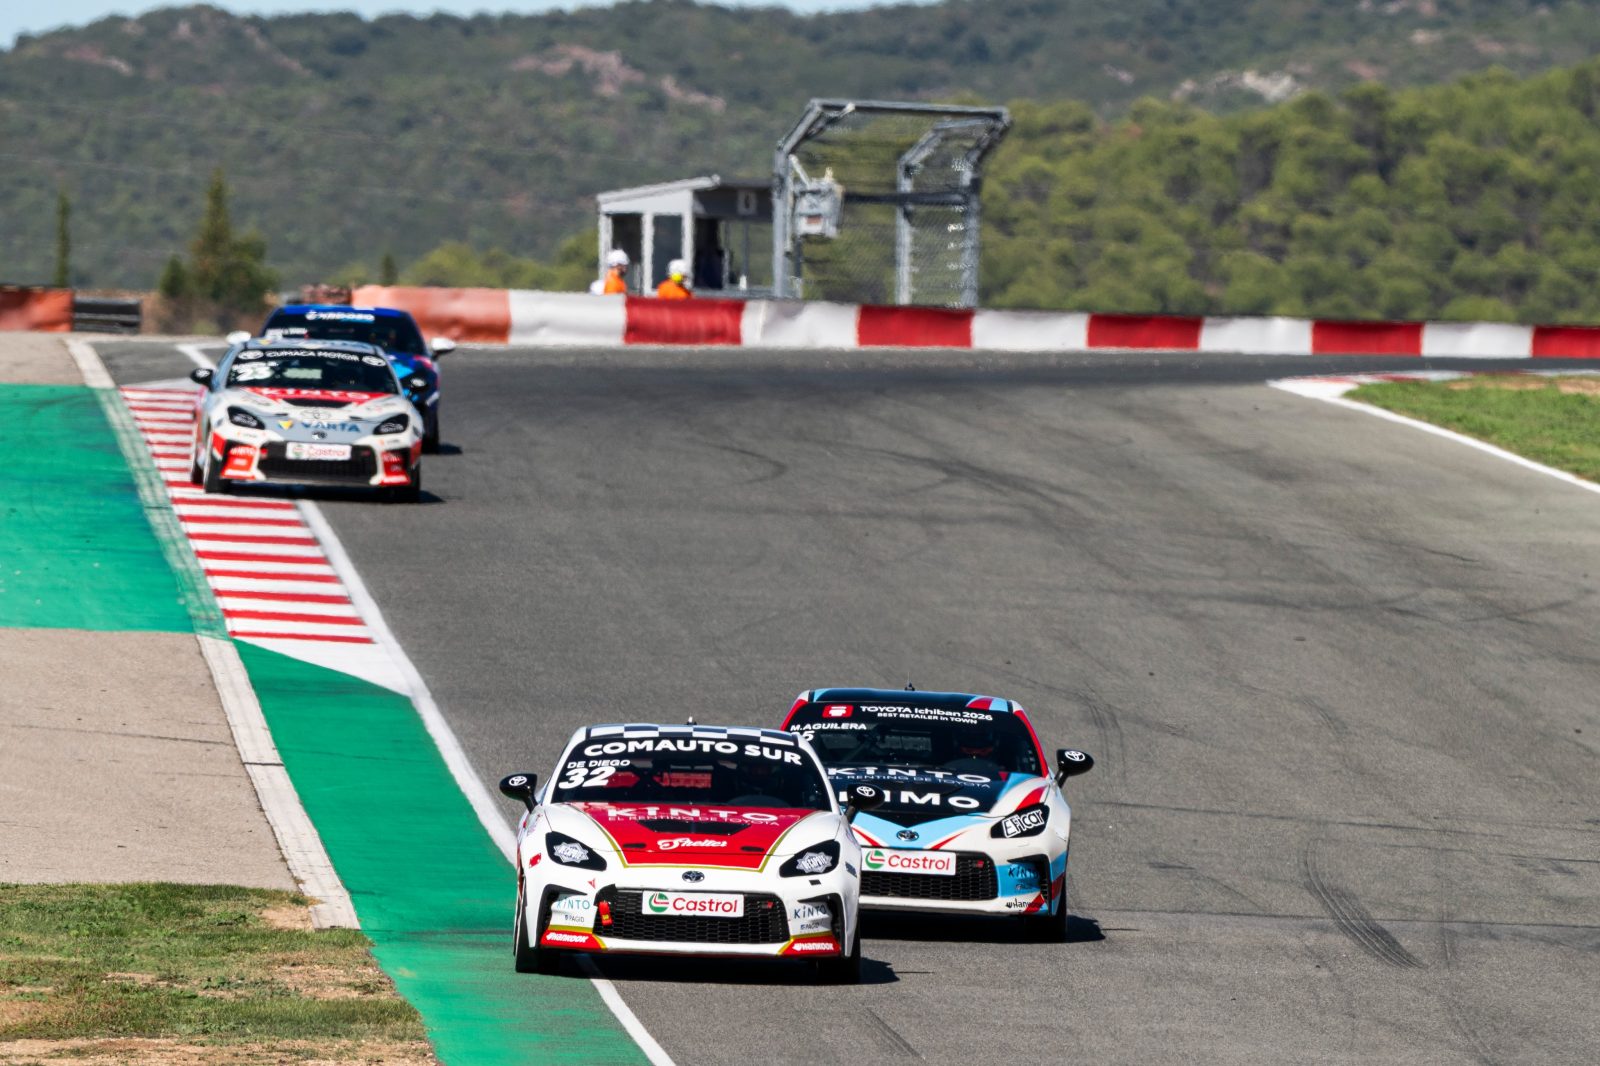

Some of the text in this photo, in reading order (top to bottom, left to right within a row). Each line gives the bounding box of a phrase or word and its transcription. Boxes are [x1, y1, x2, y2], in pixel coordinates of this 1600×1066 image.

[860, 705, 994, 721] TOYOTA Ichiban 2026
[950, 716, 978, 725] TOWN
[790, 722, 867, 732] M.AGUILERA
[583, 739, 802, 766] COMAUTO SUR
[567, 758, 631, 769] DE DIEGO
[558, 766, 617, 790] 32
[827, 766, 991, 783] KINTO
[938, 778, 991, 789] TOYOTA
[838, 790, 981, 809] IMO
[607, 806, 779, 821] KINTO
[887, 856, 950, 871] Castrol
[672, 897, 738, 914] Castrol
